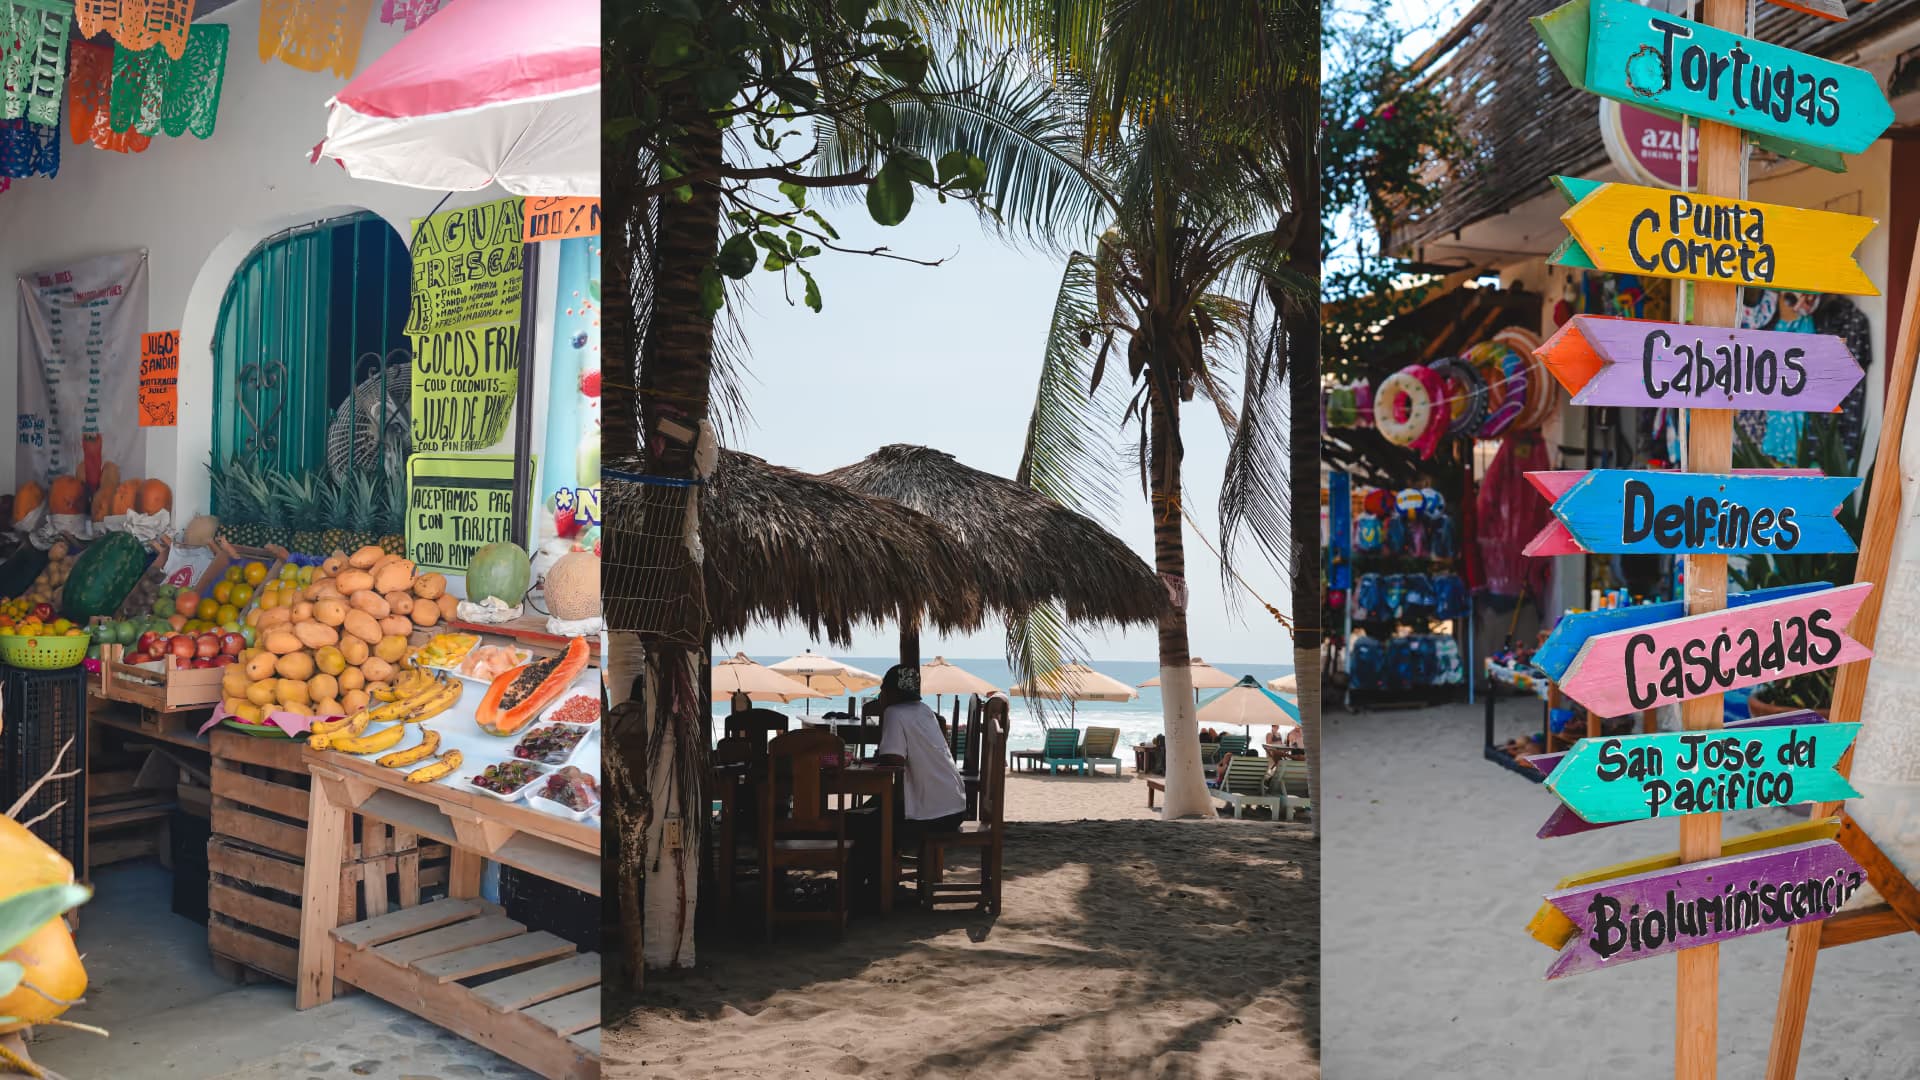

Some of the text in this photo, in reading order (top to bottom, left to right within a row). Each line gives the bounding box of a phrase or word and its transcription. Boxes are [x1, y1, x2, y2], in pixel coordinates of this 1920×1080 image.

[1649, 17, 1841, 128] Tortugas
[1641, 128, 1699, 151] azul
[1670, 194, 1764, 246] Punta
[1627, 207, 1776, 283] Cometa
[140, 356, 177, 375] SANDIA
[143, 331, 174, 356] JUGO
[418, 330, 479, 377] COCOS
[1642, 329, 1808, 400] Caballos
[424, 378, 500, 393] COLD COCONUTS
[415, 396, 457, 442] JUGO
[461, 396, 478, 440] DE
[418, 441, 439, 452] COLD
[413, 488, 512, 513] ACEPTAMOS PAG
[1622, 479, 1800, 551] Delfines
[418, 513, 511, 543] CON TARJETA
[416, 542, 480, 566] CARD PAYM
[1624, 607, 1842, 710] Cascadas
[1596, 729, 1817, 782] San Jose del
[1643, 771, 1795, 817] Pacifico
